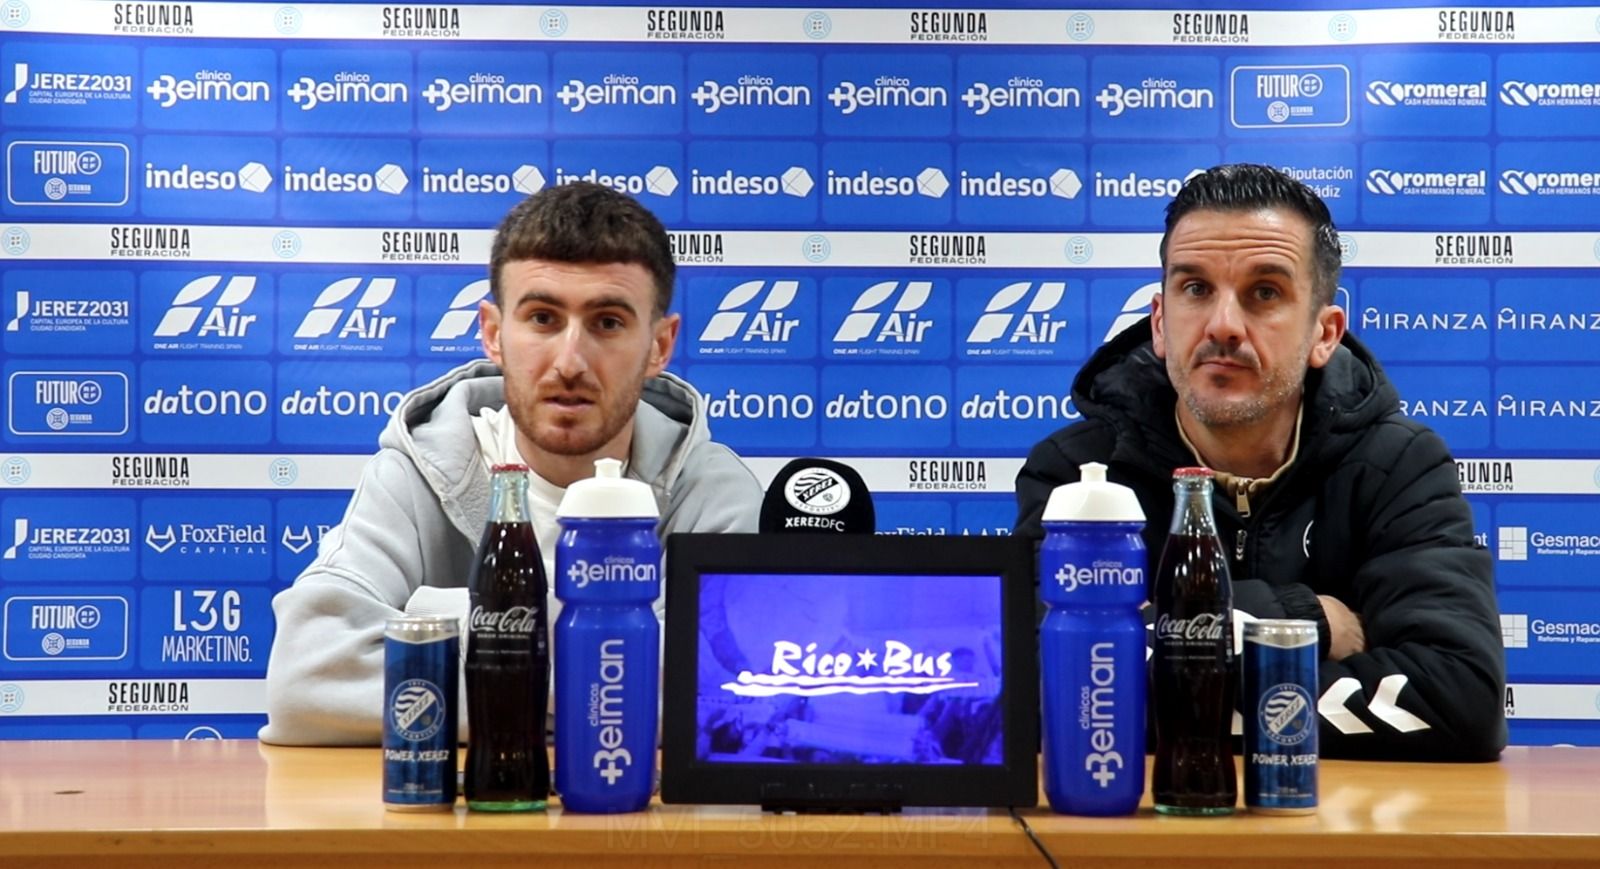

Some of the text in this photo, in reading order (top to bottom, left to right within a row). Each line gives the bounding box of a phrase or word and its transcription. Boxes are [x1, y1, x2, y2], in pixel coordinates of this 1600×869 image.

[114, 4, 194, 26] SEGUNDA
[383, 7, 460, 29] SEGUNDA
[647, 10, 724, 32] SEGUNDA
[911, 12, 987, 33] SEGUNDA
[1173, 13, 1249, 35] SEGUNDA
[1438, 10, 1515, 33] SEGUNDA
[114, 25, 195, 34] FEDERACIÓN
[383, 29, 460, 37] FEDERACIÓN
[647, 31, 725, 40] FEDERACIÓN
[1173, 34, 1249, 43] FEDERACIÓN
[1438, 32, 1515, 40] FEDERACIÓN
[31, 73, 131, 92] JEREZ2031
[195, 70, 232, 80] clínica
[334, 72, 370, 82] clínica
[469, 73, 505, 84] clínica
[603, 74, 639, 85] clínica
[738, 75, 773, 86] clínica
[874, 76, 910, 87] clínica
[1008, 77, 1043, 87] clínica
[1142, 78, 1177, 89] clínica
[1405, 81, 1487, 98] romeral
[146, 164, 236, 190] indeso
[284, 166, 372, 192] indeso
[423, 167, 510, 193] indeso
[692, 169, 778, 194] indeso
[828, 170, 914, 195] indeso
[961, 171, 1047, 196] indeso
[1095, 171, 1181, 197] indeso
[1282, 166, 1353, 181] Diputación
[1404, 171, 1486, 187] romeral
[111, 228, 190, 250] SEGUNDA
[382, 232, 459, 254] SEGUNDA
[910, 235, 986, 256] SEGUNDA
[1435, 235, 1513, 257] SEGUNDA
[111, 249, 191, 257] FEDERACIÓN
[382, 253, 459, 261] FEDERACIÓN
[1435, 256, 1513, 264] FEDERACIÓN
[31, 301, 129, 317] JEREZ2031
[1362, 307, 1488, 330] MIRANZA
[197, 309, 257, 337] Air
[338, 310, 397, 339] Air
[743, 311, 799, 342] Air
[876, 312, 934, 343] Air
[1010, 313, 1067, 343] Air
[144, 385, 267, 415] datono
[825, 389, 948, 419] datono
[112, 456, 190, 478] SEGUNDA
[909, 461, 986, 482] SEGUNDA
[112, 478, 190, 486] FEDERACIÓN
[802, 478, 833, 500] XEREZ
[909, 481, 986, 489] FEDERACIÓN
[181, 524, 266, 544] FoxField
[784, 516, 846, 532] XEREZDFC
[30, 528, 130, 544] JEREZ2031
[174, 590, 240, 631] L3G
[162, 636, 253, 662] MARKETING.
[771, 641, 952, 676] Rico Bus
[108, 682, 189, 704] SEGUNDA
[108, 704, 189, 712] FEDERACIÓN
